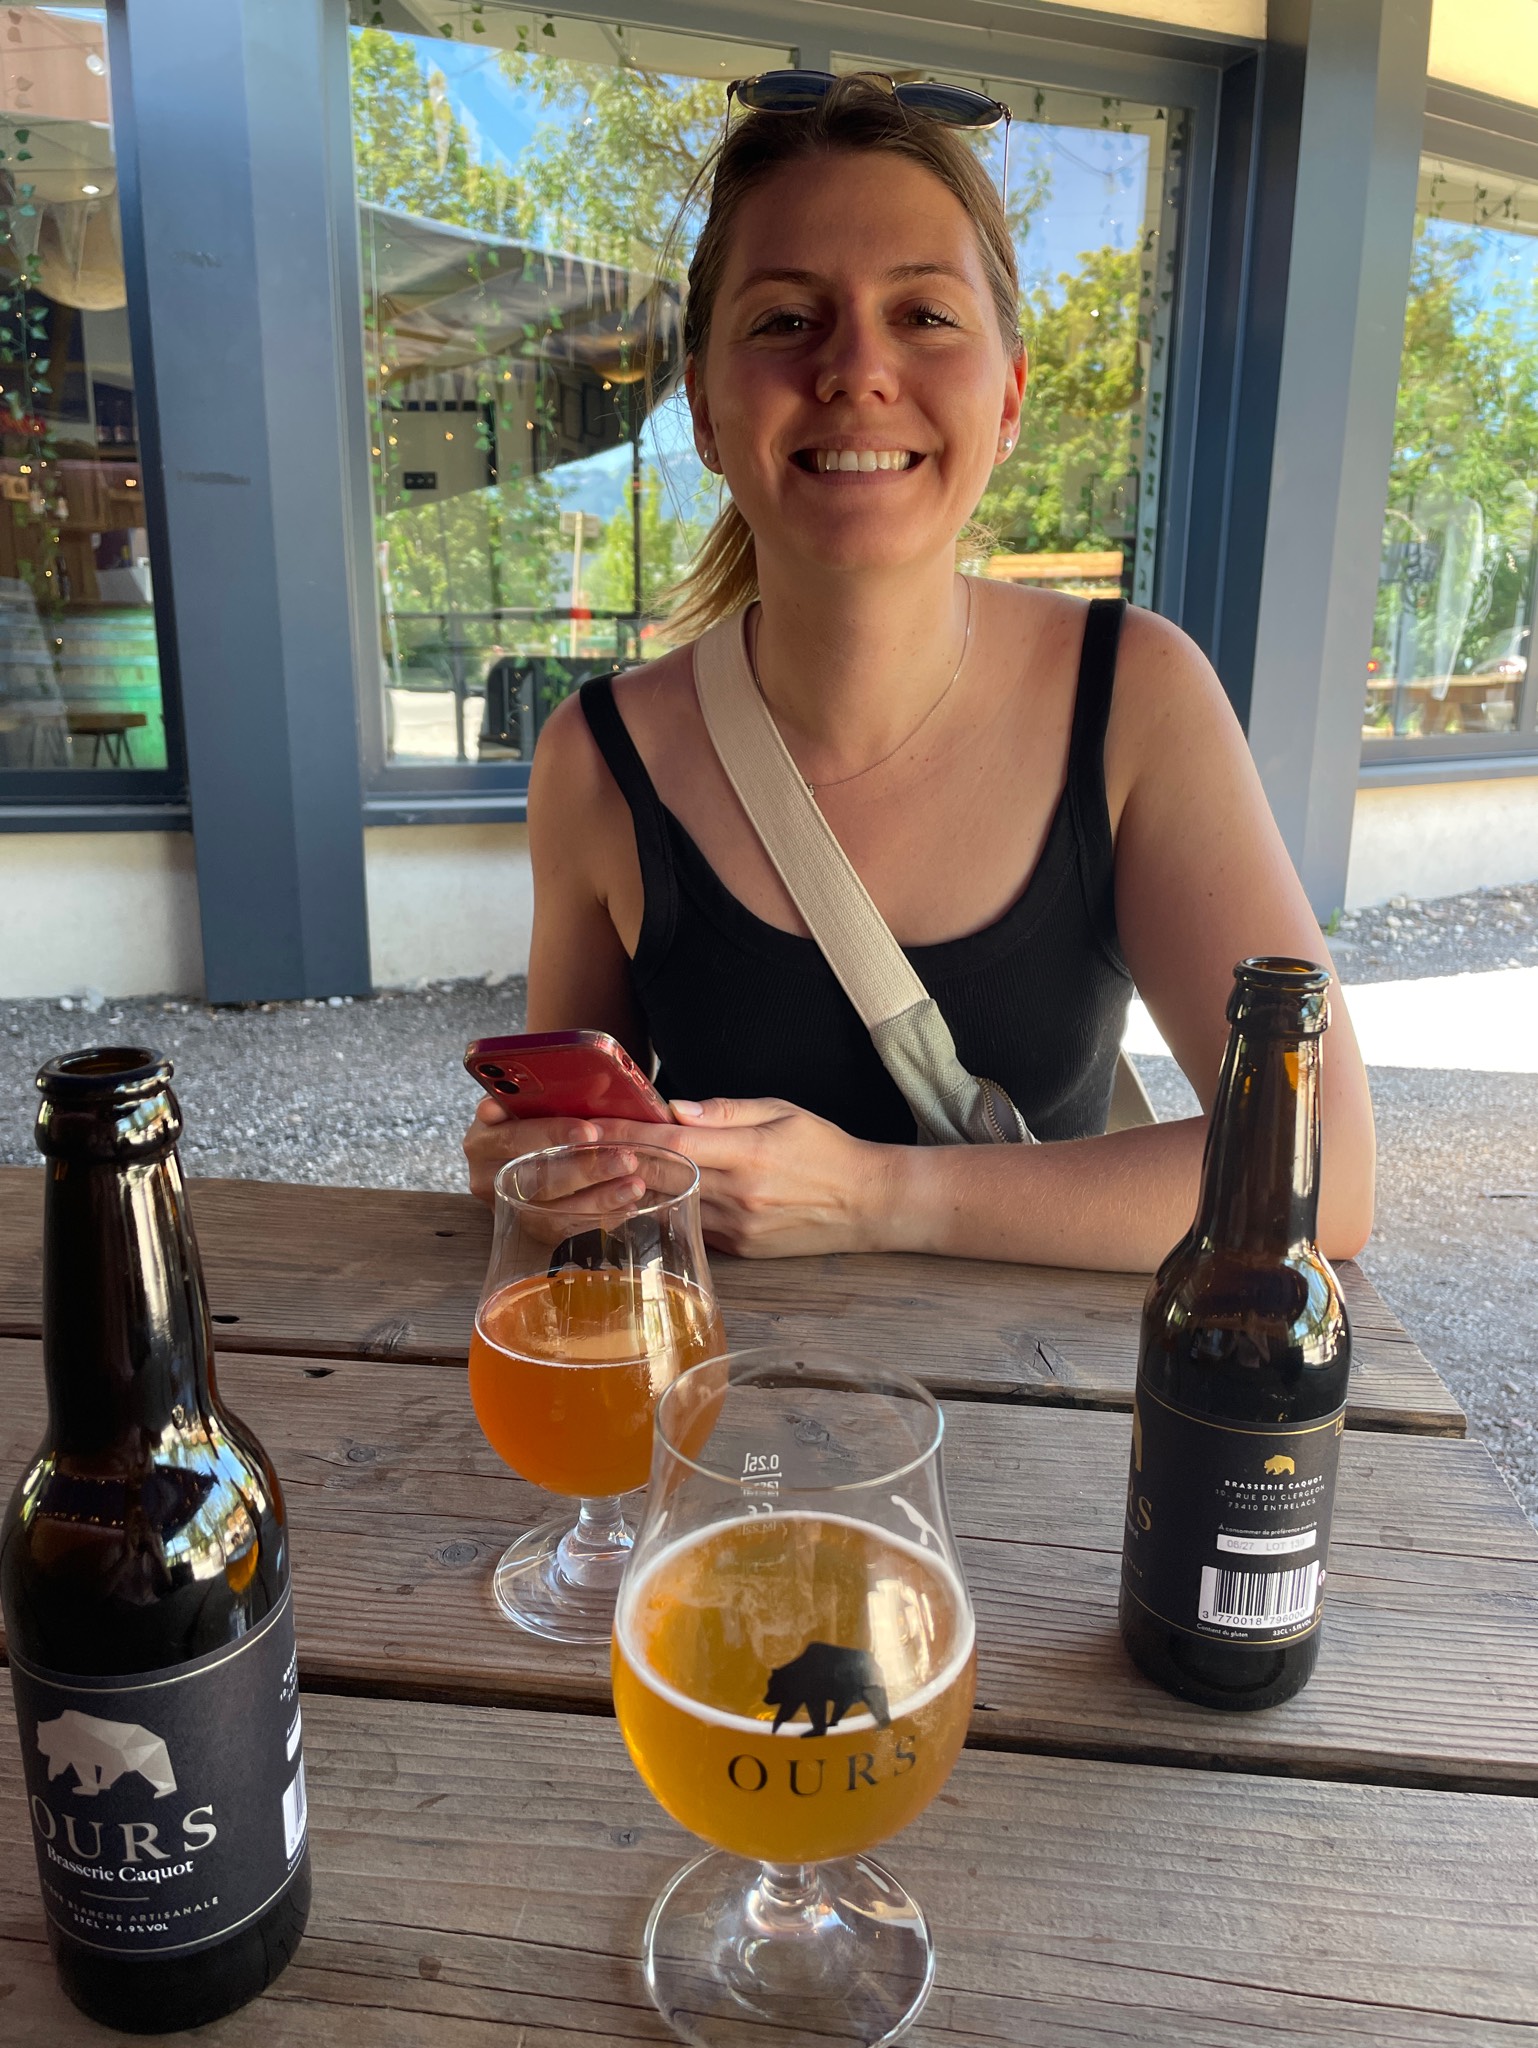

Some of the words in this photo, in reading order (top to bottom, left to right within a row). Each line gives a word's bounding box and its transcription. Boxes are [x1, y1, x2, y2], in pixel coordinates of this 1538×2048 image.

[1224, 1480, 1284, 1491] BRASSERIE
[1288, 1475, 1323, 1490] CAQUOT
[1236, 1493, 1256, 1501] RUE
[1281, 1484, 1325, 1501] CLERGEON
[1228, 1501, 1259, 1511] 73410
[1264, 1498, 1316, 1511] ENTRELACS
[1266, 1542, 1286, 1551] LOT
[1203, 1611, 1209, 1619] 3
[1218, 1614, 1262, 1625] 770018
[1269, 1609, 1305, 1625] 796000
[728, 1735, 916, 1797] OURS
[31, 1794, 218, 1863] OURS
[47, 1843, 115, 1881] Brasserie
[119, 1860, 195, 1884] Caquot
[130, 1896, 219, 1922] ARTISANALE
